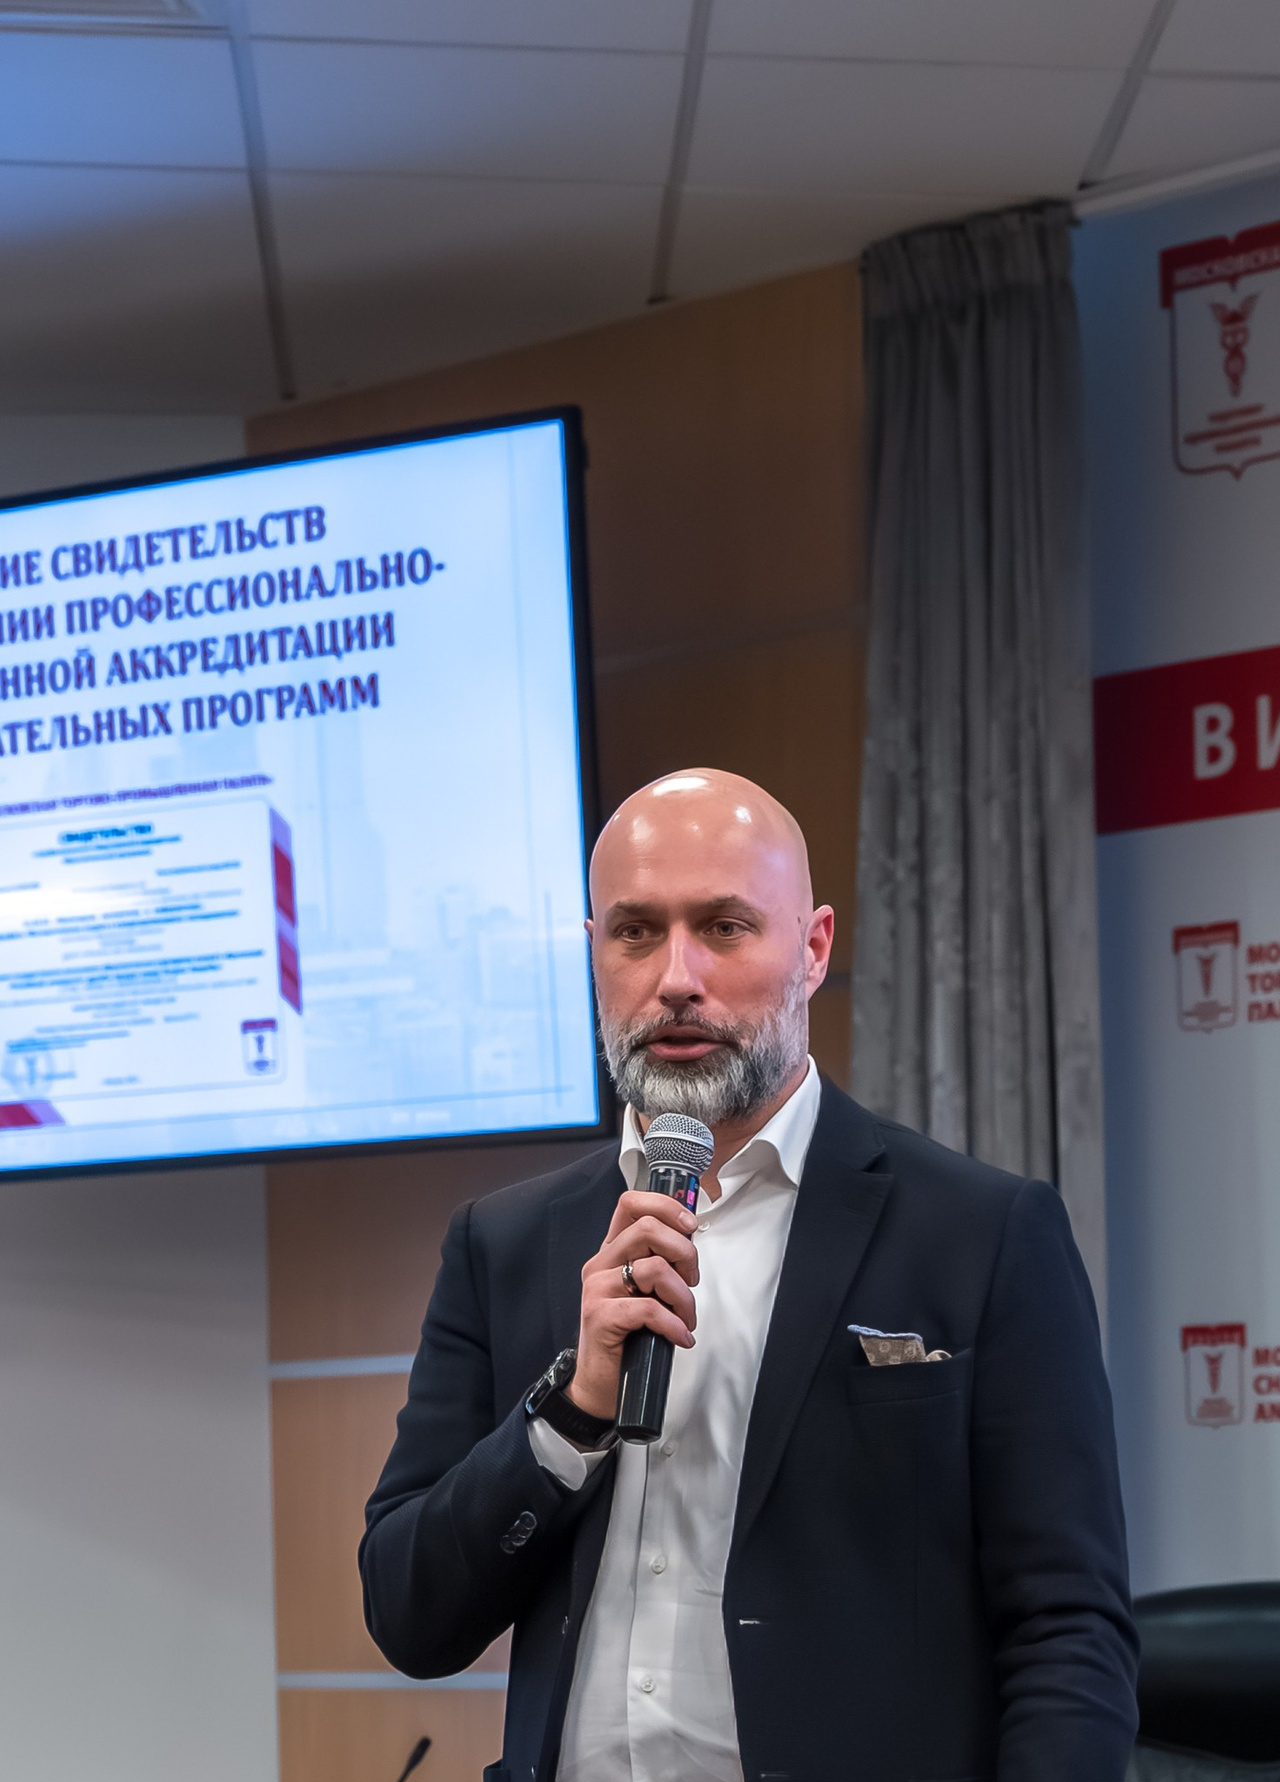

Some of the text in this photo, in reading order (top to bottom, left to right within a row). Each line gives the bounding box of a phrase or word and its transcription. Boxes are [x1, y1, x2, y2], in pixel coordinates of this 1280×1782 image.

[51, 506, 327, 581] СВИДЕТЕЛЬСТВ
[0, 547, 445, 645] ИИ ПРОФЕССИОНАЛЬНО-
[105, 612, 395, 687] АККРЕДИТАЦИИ
[183, 673, 380, 733] ПРОГРАММ
[1193, 701, 1236, 784] В
